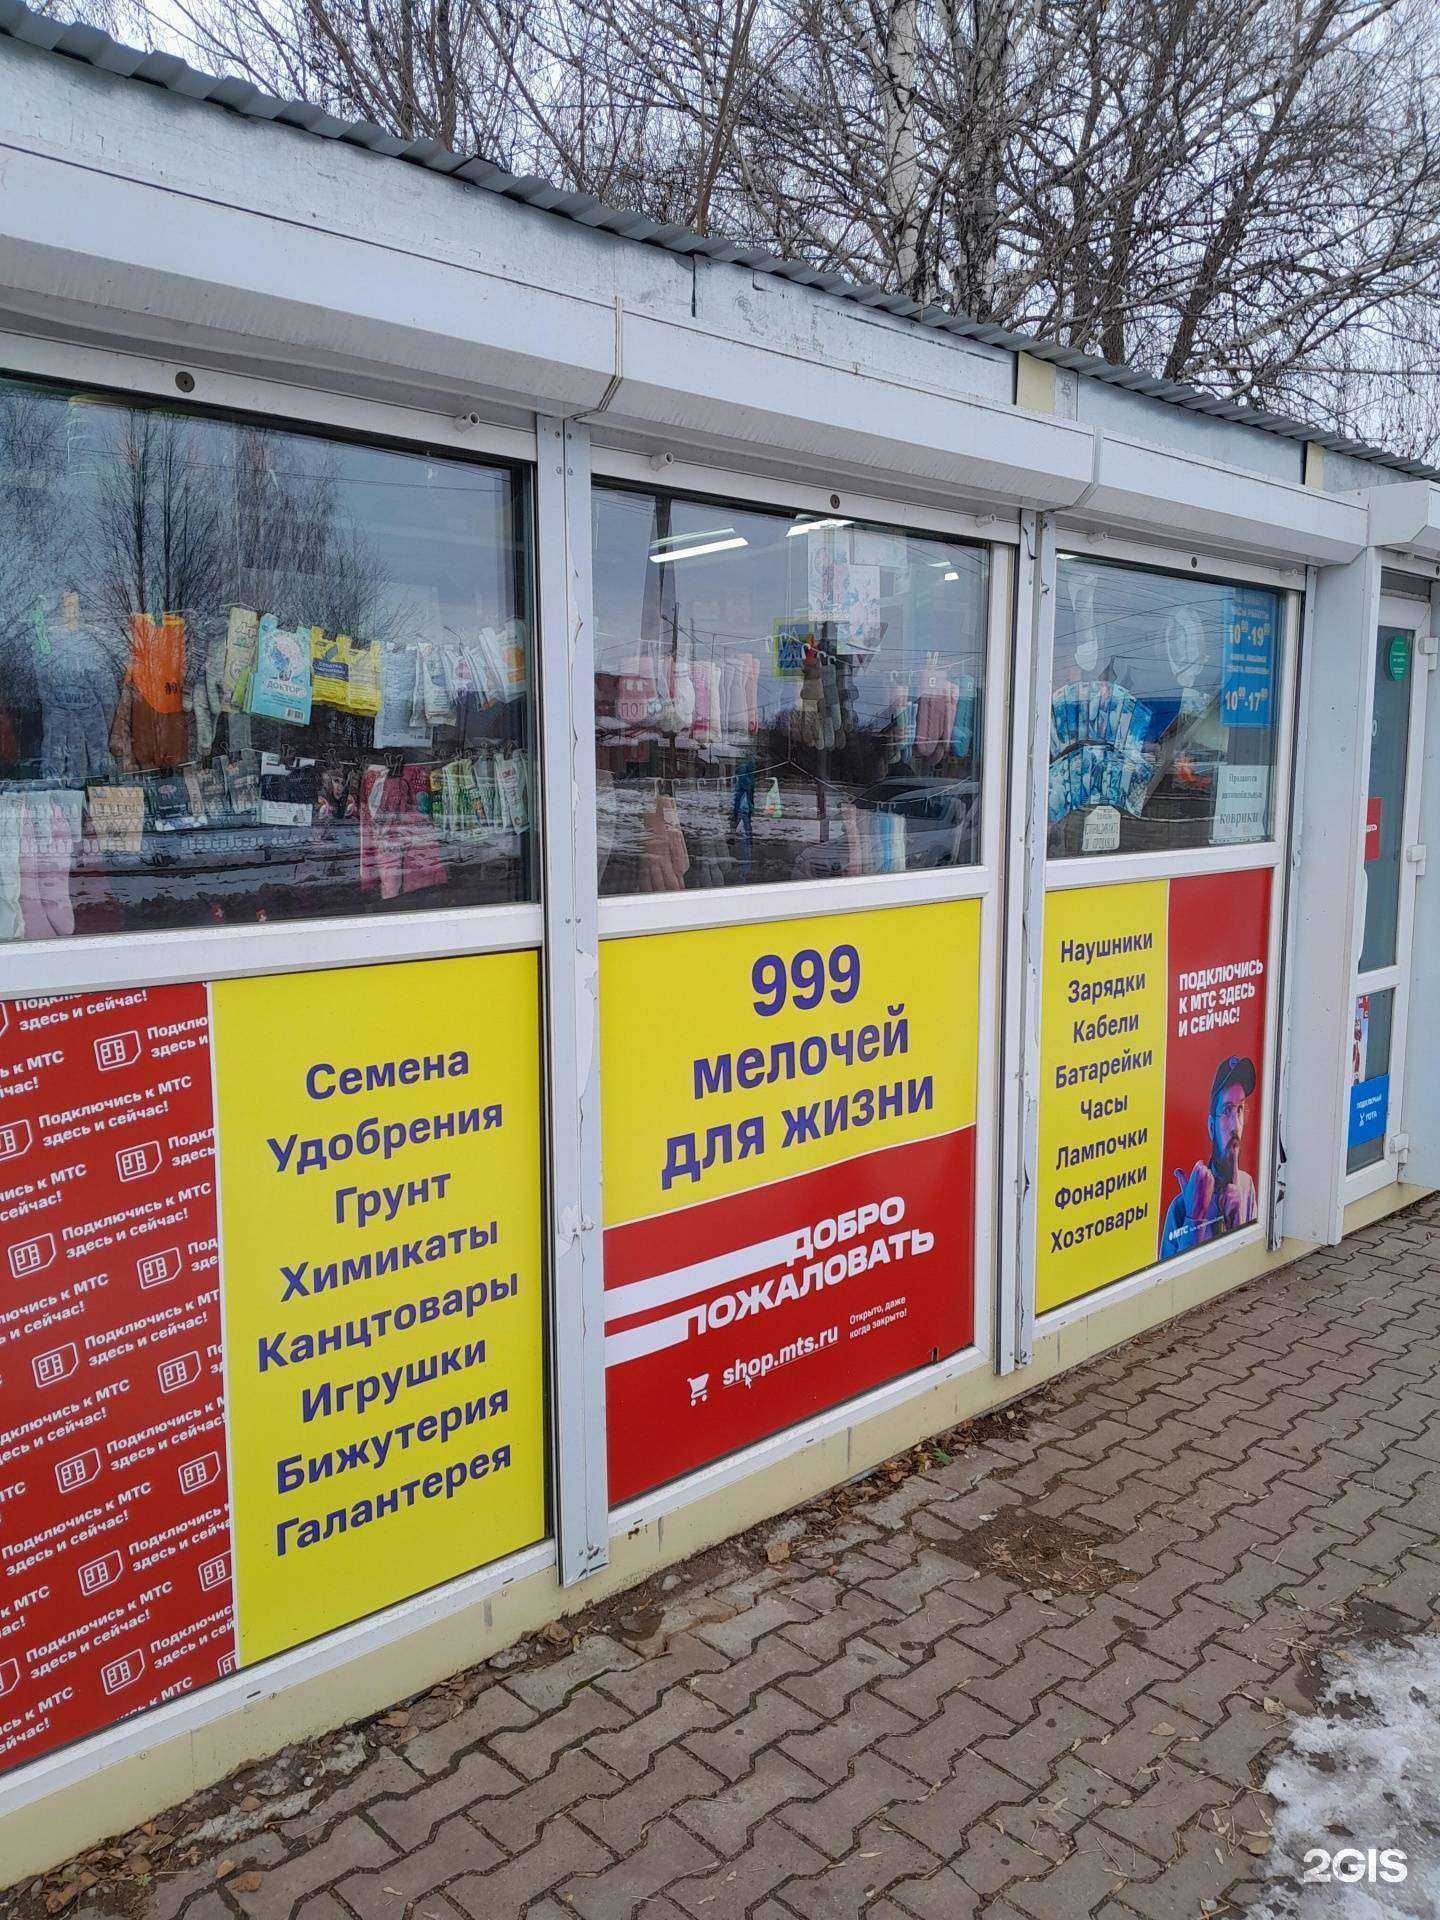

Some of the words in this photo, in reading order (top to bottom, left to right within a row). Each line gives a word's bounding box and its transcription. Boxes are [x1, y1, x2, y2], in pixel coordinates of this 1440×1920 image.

[1060, 933, 1153, 965] Наушники
[751, 944, 860, 1017] 999
[1068, 973, 1146, 1004] Зарядки
[1178, 958, 1264, 991] ПОДКЛЮЧИСЬ
[20, 1012, 69, 1030] здесь
[72, 1008, 82, 1018] и
[87, 990, 147, 1014] сейчас!
[1178, 998, 1188, 1014] К
[1190, 989, 1216, 1011] МТС
[1218, 982, 1256, 1006] ЗДЕСЬ
[1073, 1014, 1139, 1044] Кабели
[1178, 1020, 1188, 1038] И
[1190, 1007, 1240, 1034] СЕЙЧАС!
[27, 1051, 64, 1070] МТС
[151, 1039, 196, 1057] здесь
[693, 1003, 909, 1100] мелочей
[1056, 1048, 1153, 1089] Батарейки
[306, 1050, 470, 1100] Семена
[38, 1092, 142, 1128] Подключись
[145, 1089, 155, 1098] к
[158, 1076, 192, 1094] МТС
[43, 1126, 91, 1146] здесь
[94, 1120, 105, 1131] и
[108, 1100, 168, 1127] сейчас!
[1080, 1095, 1128, 1121] Часы
[266, 1103, 502, 1176] Удобрения
[661, 1115, 764, 1191] для
[781, 1075, 933, 1150] жизни
[1056, 1128, 1148, 1170] Лампочки
[37, 1178, 48, 1189] к
[50, 1164, 86, 1185] МТС
[1054, 1165, 1148, 1210] Фонарики
[62, 1202, 162, 1240] Подключись
[166, 1196, 175, 1206] к
[178, 1183, 211, 1202] МТС
[335, 1172, 451, 1228] Грунт
[66, 1236, 113, 1258] здесь
[116, 1230, 126, 1241] и
[130, 1208, 188, 1236] сейчас!
[785, 1196, 906, 1267] ДОБРО
[1051, 1202, 1148, 1253] Хозтовары
[280, 1220, 498, 1302] Химикаты
[687, 1228, 935, 1336] ПОЖАЛОВАТЬ
[60, 1290, 70, 1300] к
[74, 1274, 109, 1296] МТС
[850, 1306, 884, 1324] Открыто,
[885, 1296, 906, 1311] даже
[24, 1300, 85, 1334] сейчас!
[84, 1306, 182, 1350] Подключись
[185, 1301, 194, 1311] к
[89, 1343, 134, 1366] здесь
[137, 1336, 147, 1347] и
[151, 1311, 207, 1342] сейчас!
[258, 1273, 518, 1372] Канцтовары
[850, 1324, 870, 1340] когда
[872, 1308, 907, 1328] закрыто!
[722, 1326, 838, 1378] shop.mts.ru
[83, 1397, 93, 1407] к
[96, 1380, 130, 1402] МТС
[302, 1339, 486, 1423] Игрушки
[34, 1436, 44, 1448] и
[48, 1407, 106, 1441] сейчас!
[106, 1408, 202, 1454] Подключись
[205, 1402, 214, 1413] к
[277, 1389, 508, 1494] Бижутерия
[111, 1447, 155, 1470] здесь
[158, 1440, 168, 1450] и
[2, 1508, 102, 1559] Подключись
[105, 1500, 114, 1511] к
[118, 1482, 151, 1505] МТС
[276, 1444, 512, 1557] Галантерея
[6, 1550, 53, 1576] здесь
[56, 1540, 66, 1552] и
[70, 1510, 128, 1545] сейчас!
[129, 1509, 221, 1555] Подключись
[133, 1547, 176, 1571] здесь
[179, 1539, 188, 1549] и
[14, 1586, 50, 1611] МТС
[26, 1609, 124, 1662] Подключись
[128, 1600, 136, 1610] к
[140, 1582, 172, 1604] МТС
[31, 1651, 77, 1678] здесь
[80, 1642, 90, 1653] и
[94, 1609, 150, 1646] сейчас!
[154, 1644, 196, 1668] здесь
[199, 1635, 208, 1645] и
[25, 1709, 35, 1720] к
[38, 1687, 73, 1713] МТС
[161, 1677, 192, 1700] МТС
